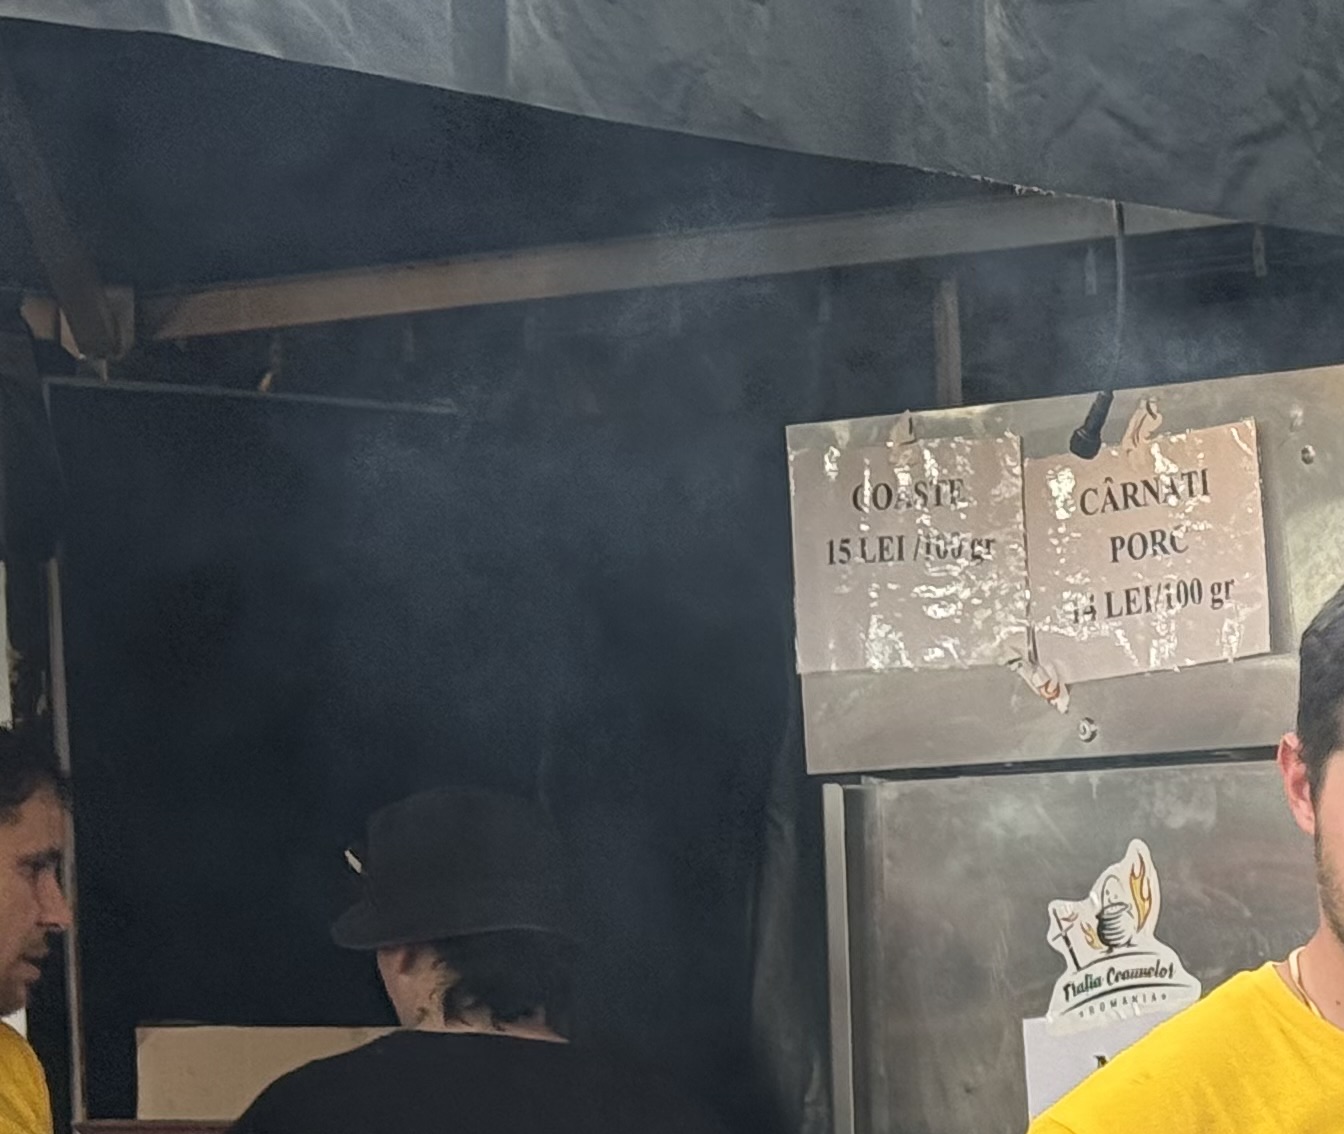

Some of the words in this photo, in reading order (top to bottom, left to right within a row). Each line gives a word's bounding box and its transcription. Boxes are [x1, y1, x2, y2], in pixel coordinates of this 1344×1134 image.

[852, 478, 964, 513] COASTE
[826, 537, 852, 566] 15
[859, 534, 905, 564] LEI
[1109, 524, 1190, 564] PORC
[1210, 578, 1236, 611] gr
